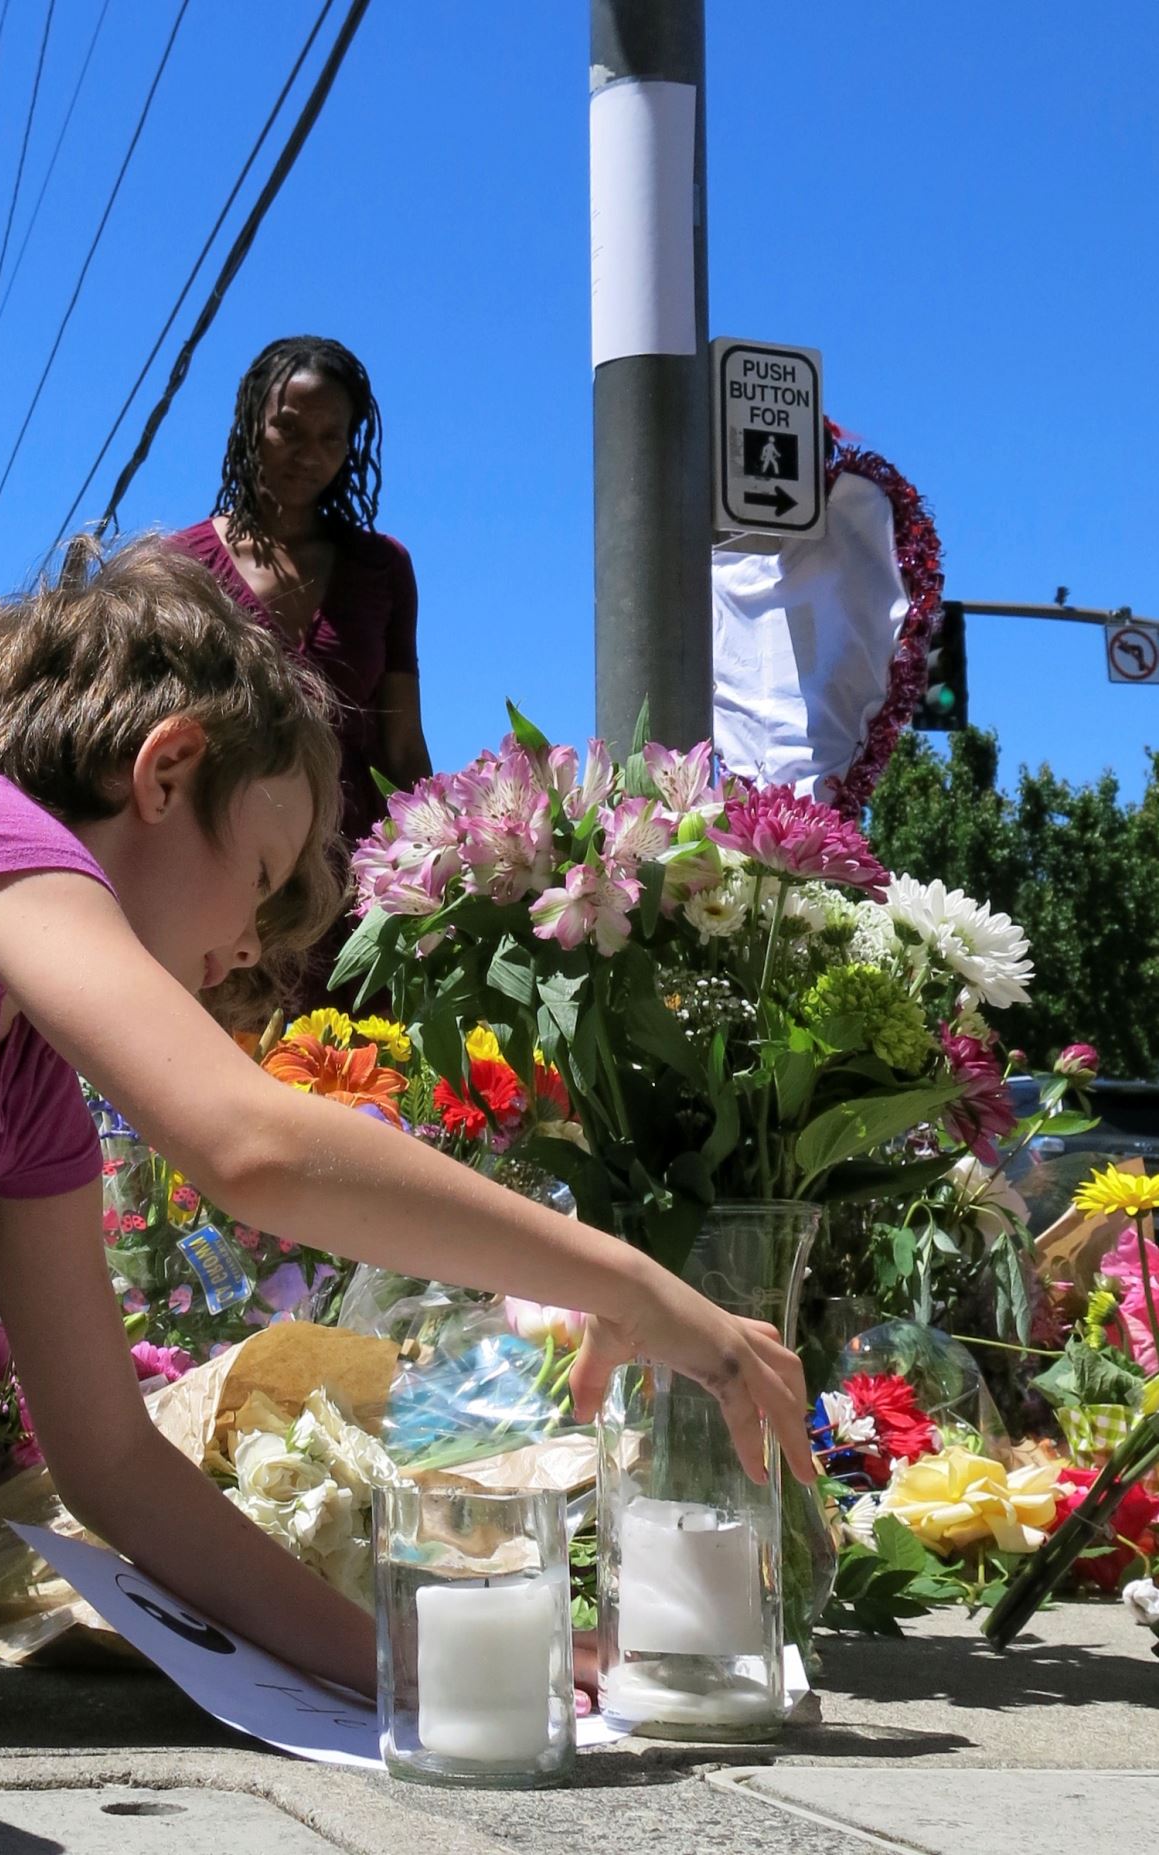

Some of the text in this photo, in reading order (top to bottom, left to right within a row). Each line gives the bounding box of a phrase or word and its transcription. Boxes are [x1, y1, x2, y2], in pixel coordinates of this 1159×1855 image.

[743, 359, 795, 382] PUSH
[730, 381, 809, 407] BUTTON
[750, 406, 789, 427] FOR
